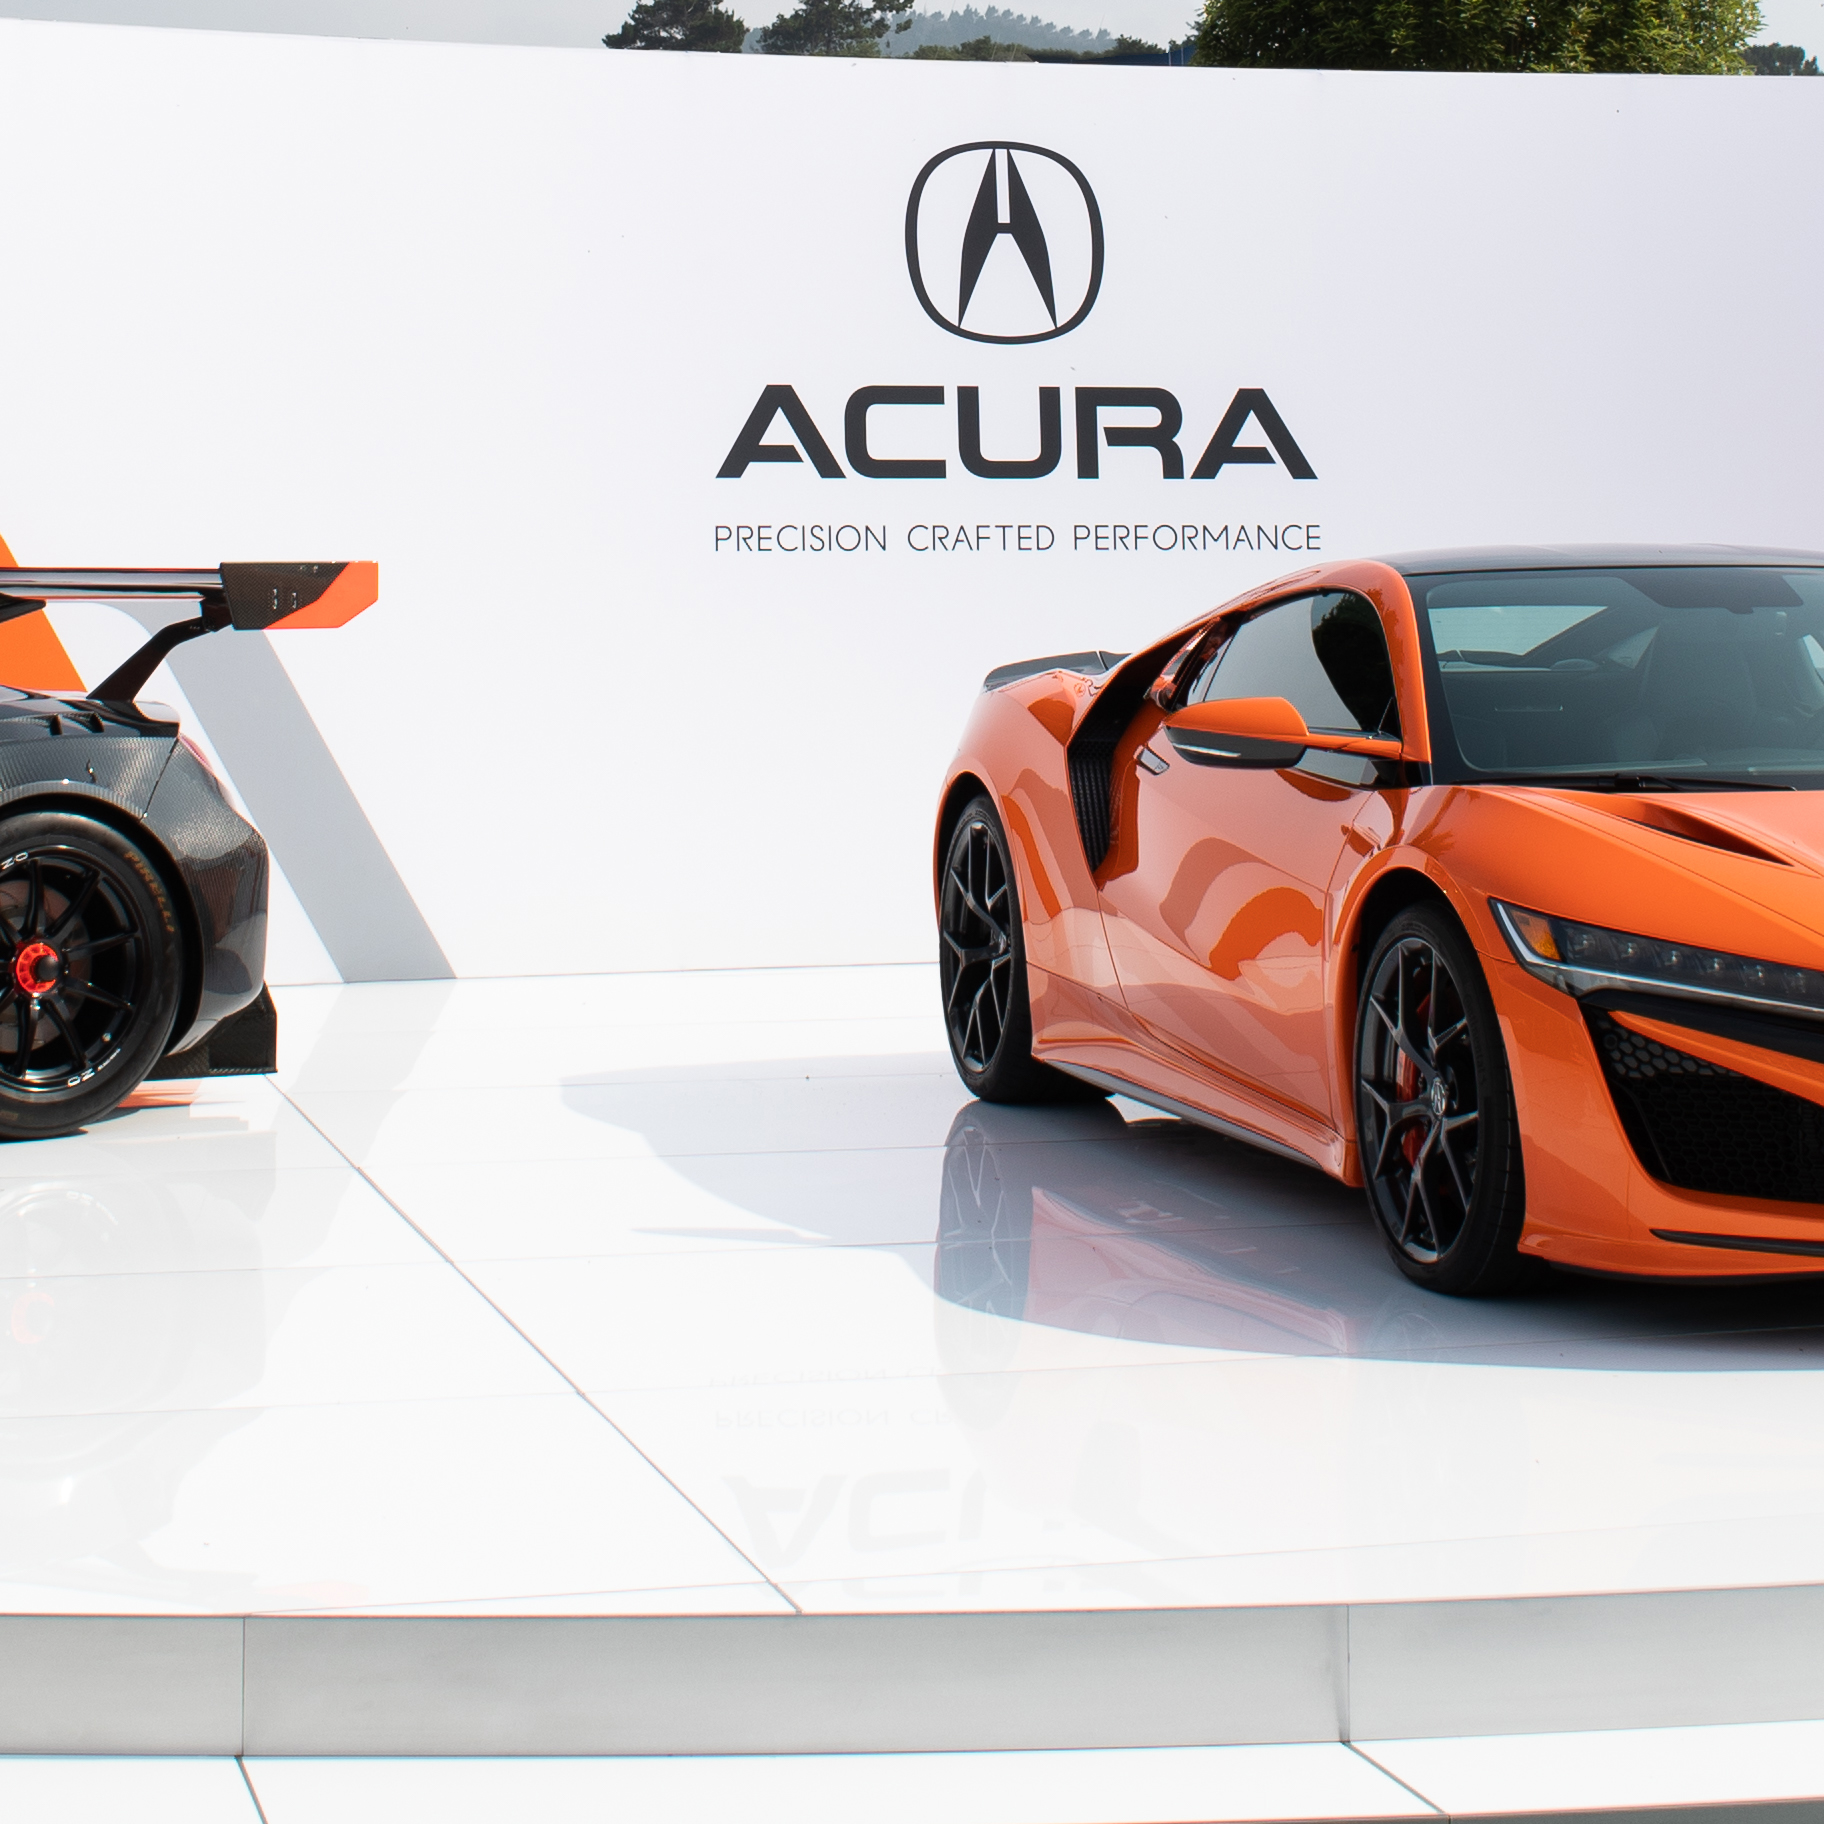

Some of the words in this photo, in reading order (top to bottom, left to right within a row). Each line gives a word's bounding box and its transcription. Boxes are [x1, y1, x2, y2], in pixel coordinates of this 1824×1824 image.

[715, 384, 1319, 480] ACURA
[714, 524, 887, 553] PRECISION
[907, 524, 1055, 552] CRAFTED
[1074, 524, 1322, 552] PERFORMANCE
[125, 850, 173, 933] PIRELLI
